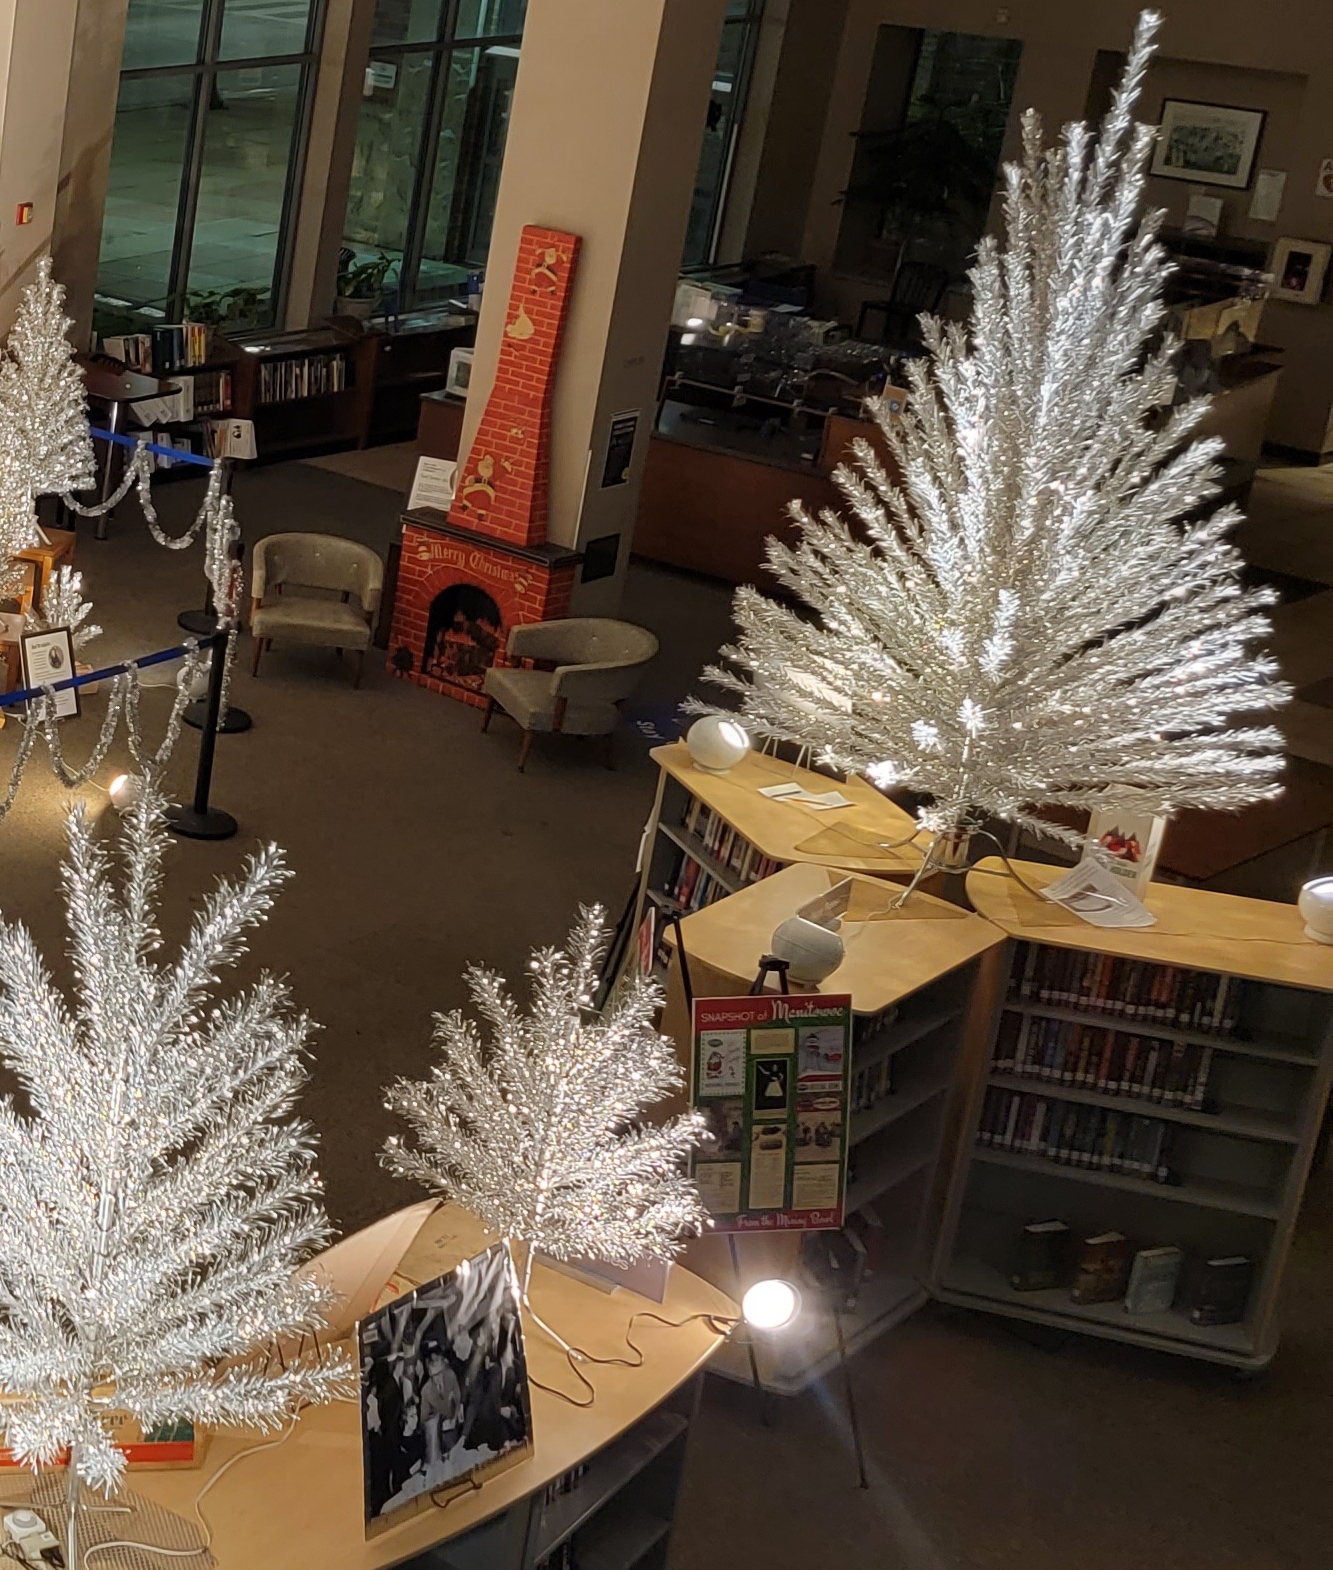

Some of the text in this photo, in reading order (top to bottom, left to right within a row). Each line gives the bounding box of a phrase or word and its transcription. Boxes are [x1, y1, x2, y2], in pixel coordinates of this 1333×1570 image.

[431, 543, 465, 569] Merry
[700, 1010, 755, 1023] SNAPSHOT
[771, 1000, 844, 1024] Manitowoc
[736, 1213, 760, 1228] From
[761, 1211, 774, 1226] the
